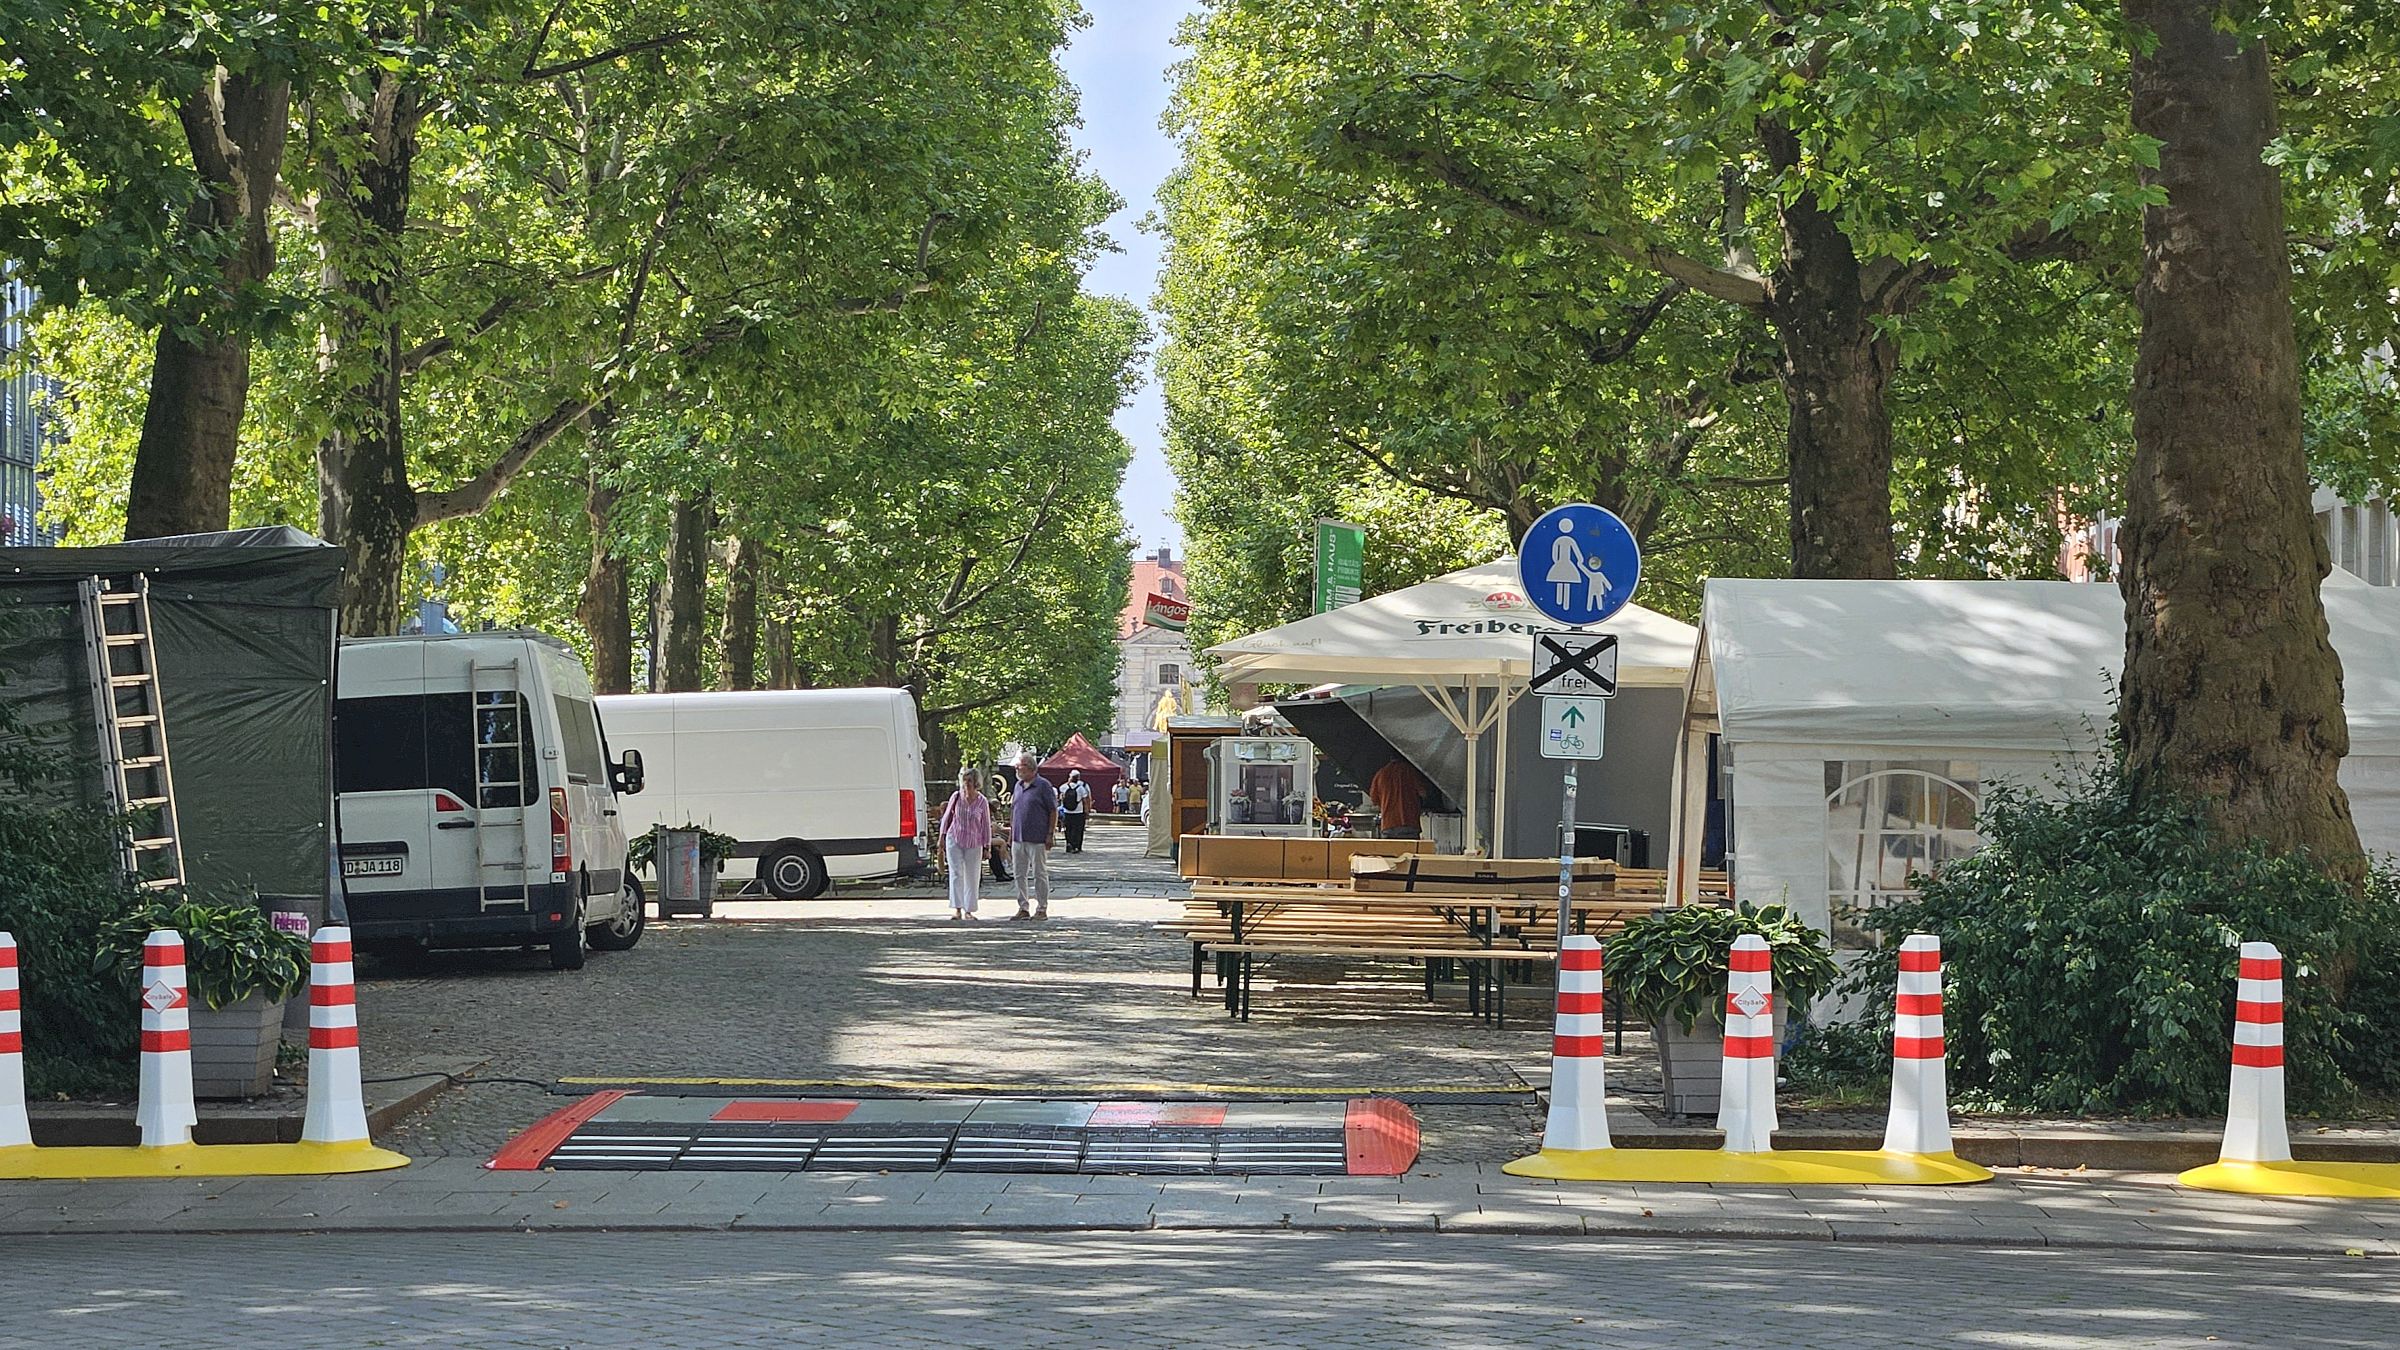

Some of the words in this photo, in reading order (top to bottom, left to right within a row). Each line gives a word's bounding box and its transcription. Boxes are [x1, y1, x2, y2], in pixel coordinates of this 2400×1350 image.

[1328, 533, 1337, 572] HAUS
[1147, 600, 1187, 617] Lángos
[1414, 619, 1560, 636] Freiber
[1561, 674, 1588, 689] frei
[361, 861, 376, 873] JA
[378, 860, 400, 872] 118
[1737, 999, 1765, 1007] CitySafe
